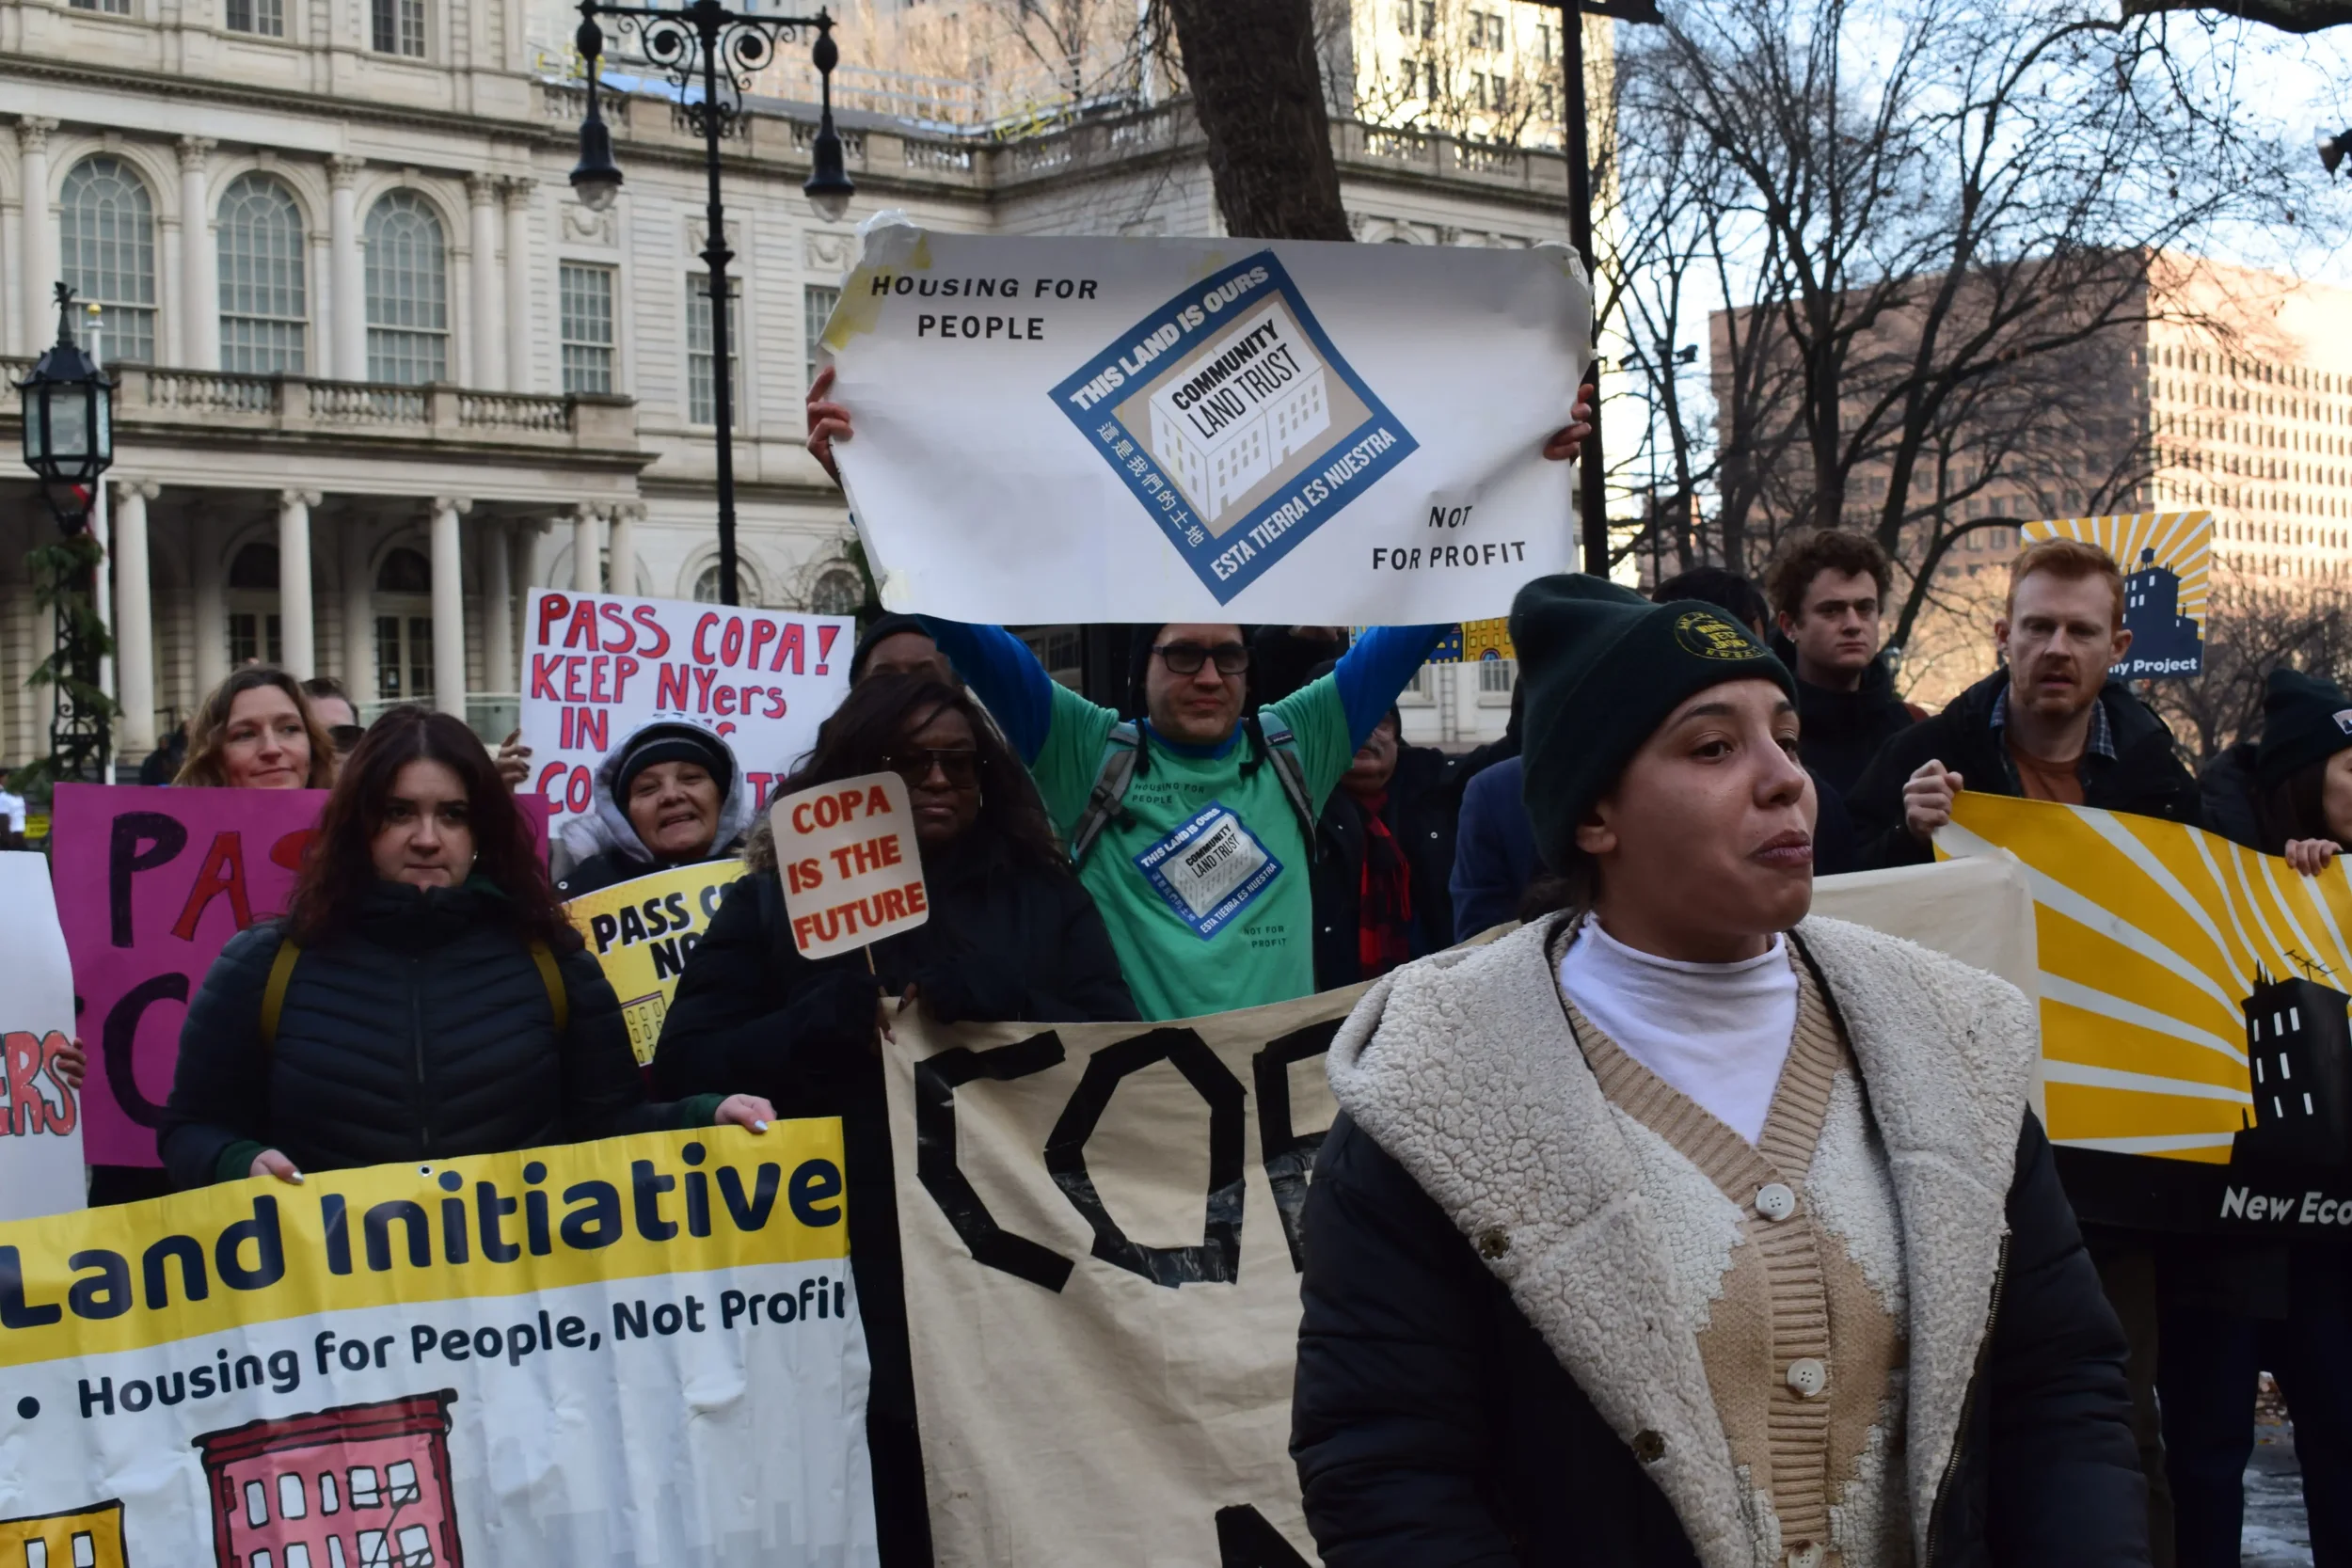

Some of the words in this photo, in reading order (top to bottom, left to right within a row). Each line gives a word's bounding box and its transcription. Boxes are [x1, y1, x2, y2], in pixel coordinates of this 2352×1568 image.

[871, 276, 1020, 298] HOUSING
[1035, 278, 1099, 300] FOR
[917, 315, 1044, 341] PEOPLE
[1069, 366, 1125, 411] THIS
[1118, 323, 1181, 376] LAND
[1176, 305, 1205, 333] IS
[1202, 266, 1269, 313] OURS
[1171, 319, 1279, 410] COMMUNITY
[1187, 388, 1247, 439] LAND
[1233, 342, 1301, 404] TRUST
[1096, 421, 1205, 547] 這是我們的土地
[1210, 539, 1257, 581] ESTA
[1248, 496, 1310, 549] TIERRA
[1302, 479, 1329, 507] ES
[1323, 427, 1397, 490] NUESTRA
[1428, 505, 1473, 528] NOT
[1373, 547, 1422, 570] FOR
[1429, 541, 1525, 568] PROFIT
[538, 594, 671, 658] PASS
[691, 611, 841, 675] COPA!
[532, 653, 640, 704] KEEP
[656, 662, 787, 719] NYers
[2133, 657, 2198, 673] Project
[560, 706, 609, 752] IN
[792, 784, 893, 834] COPA
[1132, 795, 1173, 804] PEOPLE
[1135, 783, 1180, 793] HOUSING
[1184, 784, 1204, 794] FOR
[787, 857, 823, 895] IS
[830, 833, 901, 879] THE
[1140, 847, 1166, 867] THIS
[1163, 830, 1190, 851] LAND
[1186, 824, 1199, 835] IS
[1195, 808, 1220, 826] OURS
[1185, 823, 1232, 867] COMMUNITY
[1191, 855, 1217, 879] LAND
[1216, 833, 1241, 862] TRUST
[591, 893, 691, 955] PASS
[792, 880, 927, 950] FUTURE
[1200, 917, 1219, 933] ESTA
[1214, 897, 1240, 921] TIERRA
[1236, 889, 1249, 901] ES
[1246, 863, 1278, 893] NUESTRA
[1244, 927, 1262, 935] NOT
[1265, 926, 1284, 934] FOR
[1251, 938, 1287, 948] PROFIT
[2220, 1185, 2296, 1222] New
[0, 1195, 286, 1330] Land
[321, 1141, 843, 1276] Initiative
[78, 1348, 301, 1418] Housing
[315, 1330, 395, 1374] for
[411, 1310, 601, 1367] People,
[612, 1295, 707, 1340] Not
[720, 1276, 845, 1329] Profit
